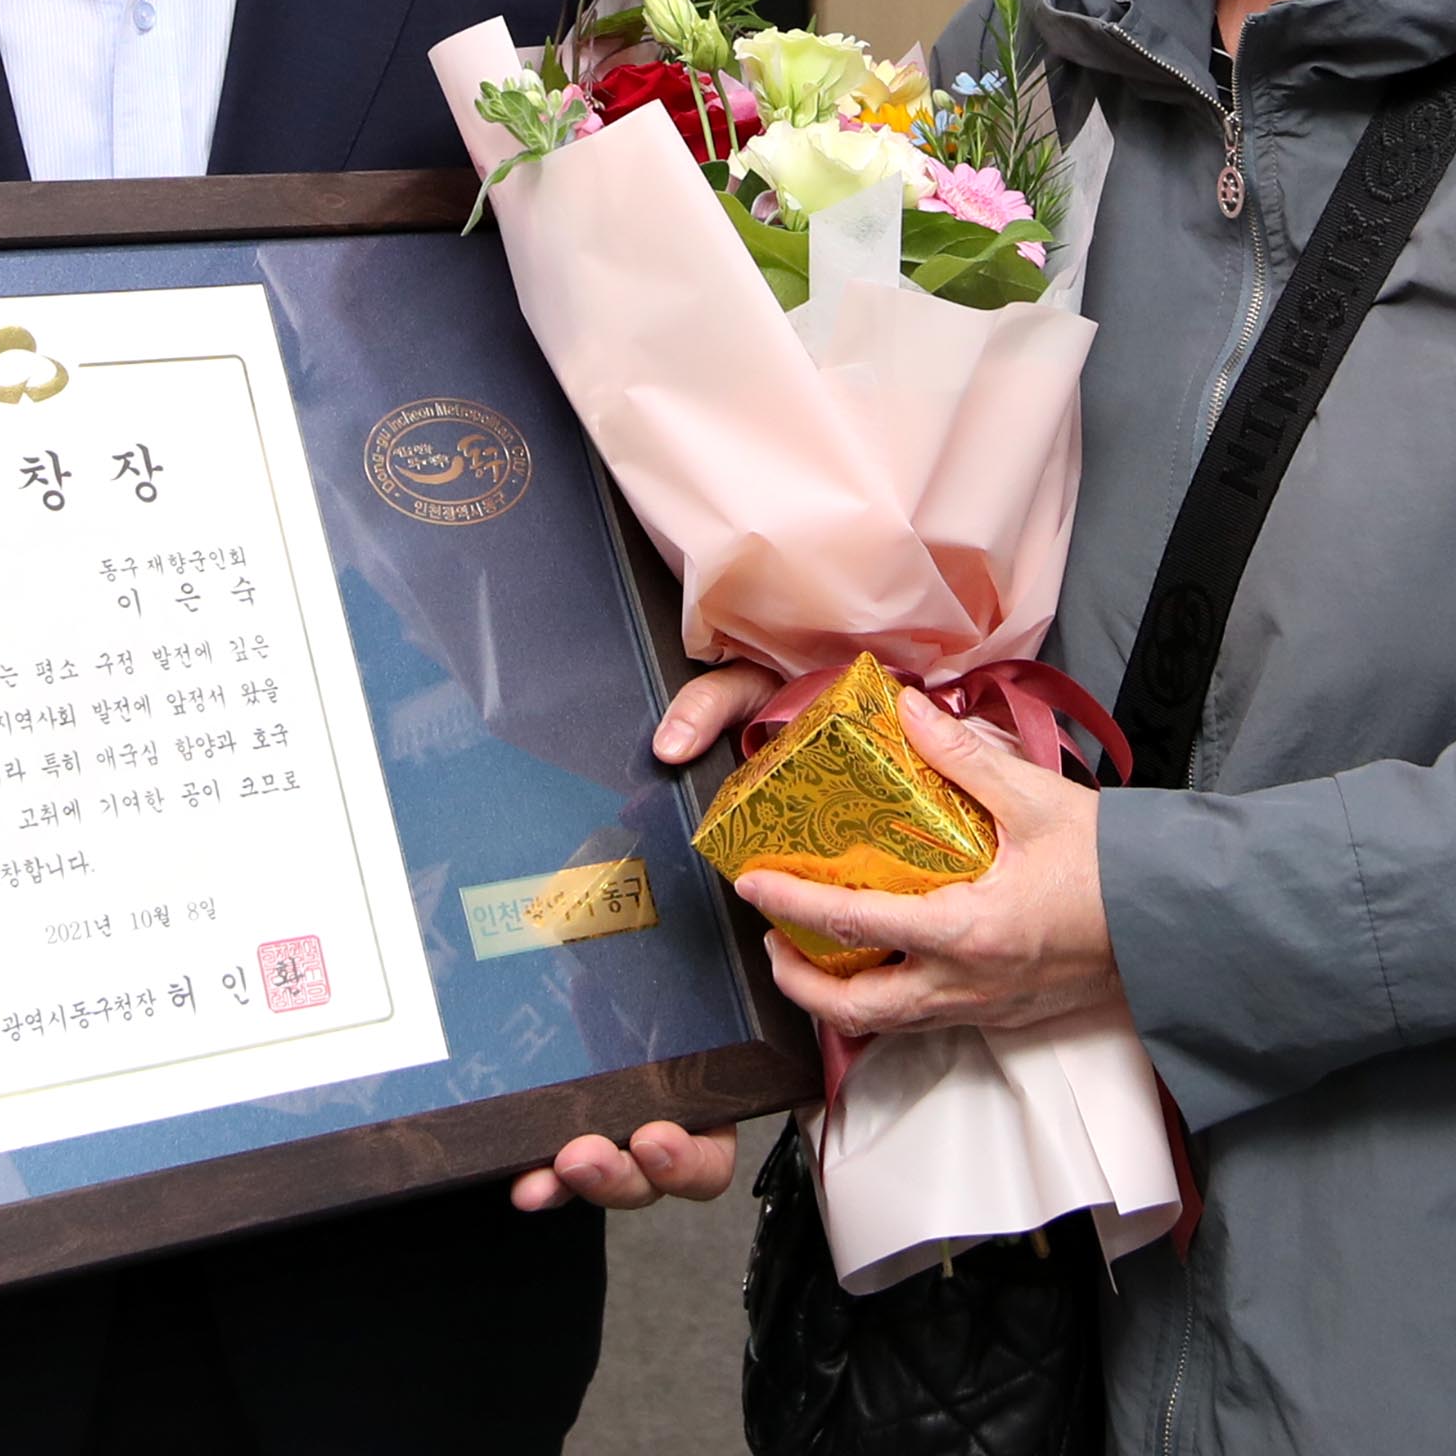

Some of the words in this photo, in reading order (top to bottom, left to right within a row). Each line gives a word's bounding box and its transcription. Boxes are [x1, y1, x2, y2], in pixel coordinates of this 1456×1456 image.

[98, 556, 140, 583] 동구
[147, 546, 247, 575] 재향군인회
[35, 658, 79, 685] 평소
[95, 649, 134, 675] 구정
[152, 641, 212, 669] 발전에
[229, 634, 270, 663] 깊은
[91, 696, 151, 725] 발전에
[241, 677, 279, 705] 왔을
[41, 750, 81, 778] 특히
[96, 740, 159, 768] 애국심
[175, 730, 237, 762] 함양과
[252, 723, 289, 750] 호국
[19, 801, 81, 830] 고취에
[99, 787, 165, 816] 기여한
[181, 778, 221, 808] 공이
[239, 770, 301, 798] 크므로
[601, 876, 644, 915] 동구
[44, 913, 112, 945] 2021년
[130, 904, 171, 931] 10월
[186, 897, 217, 921] 8일
